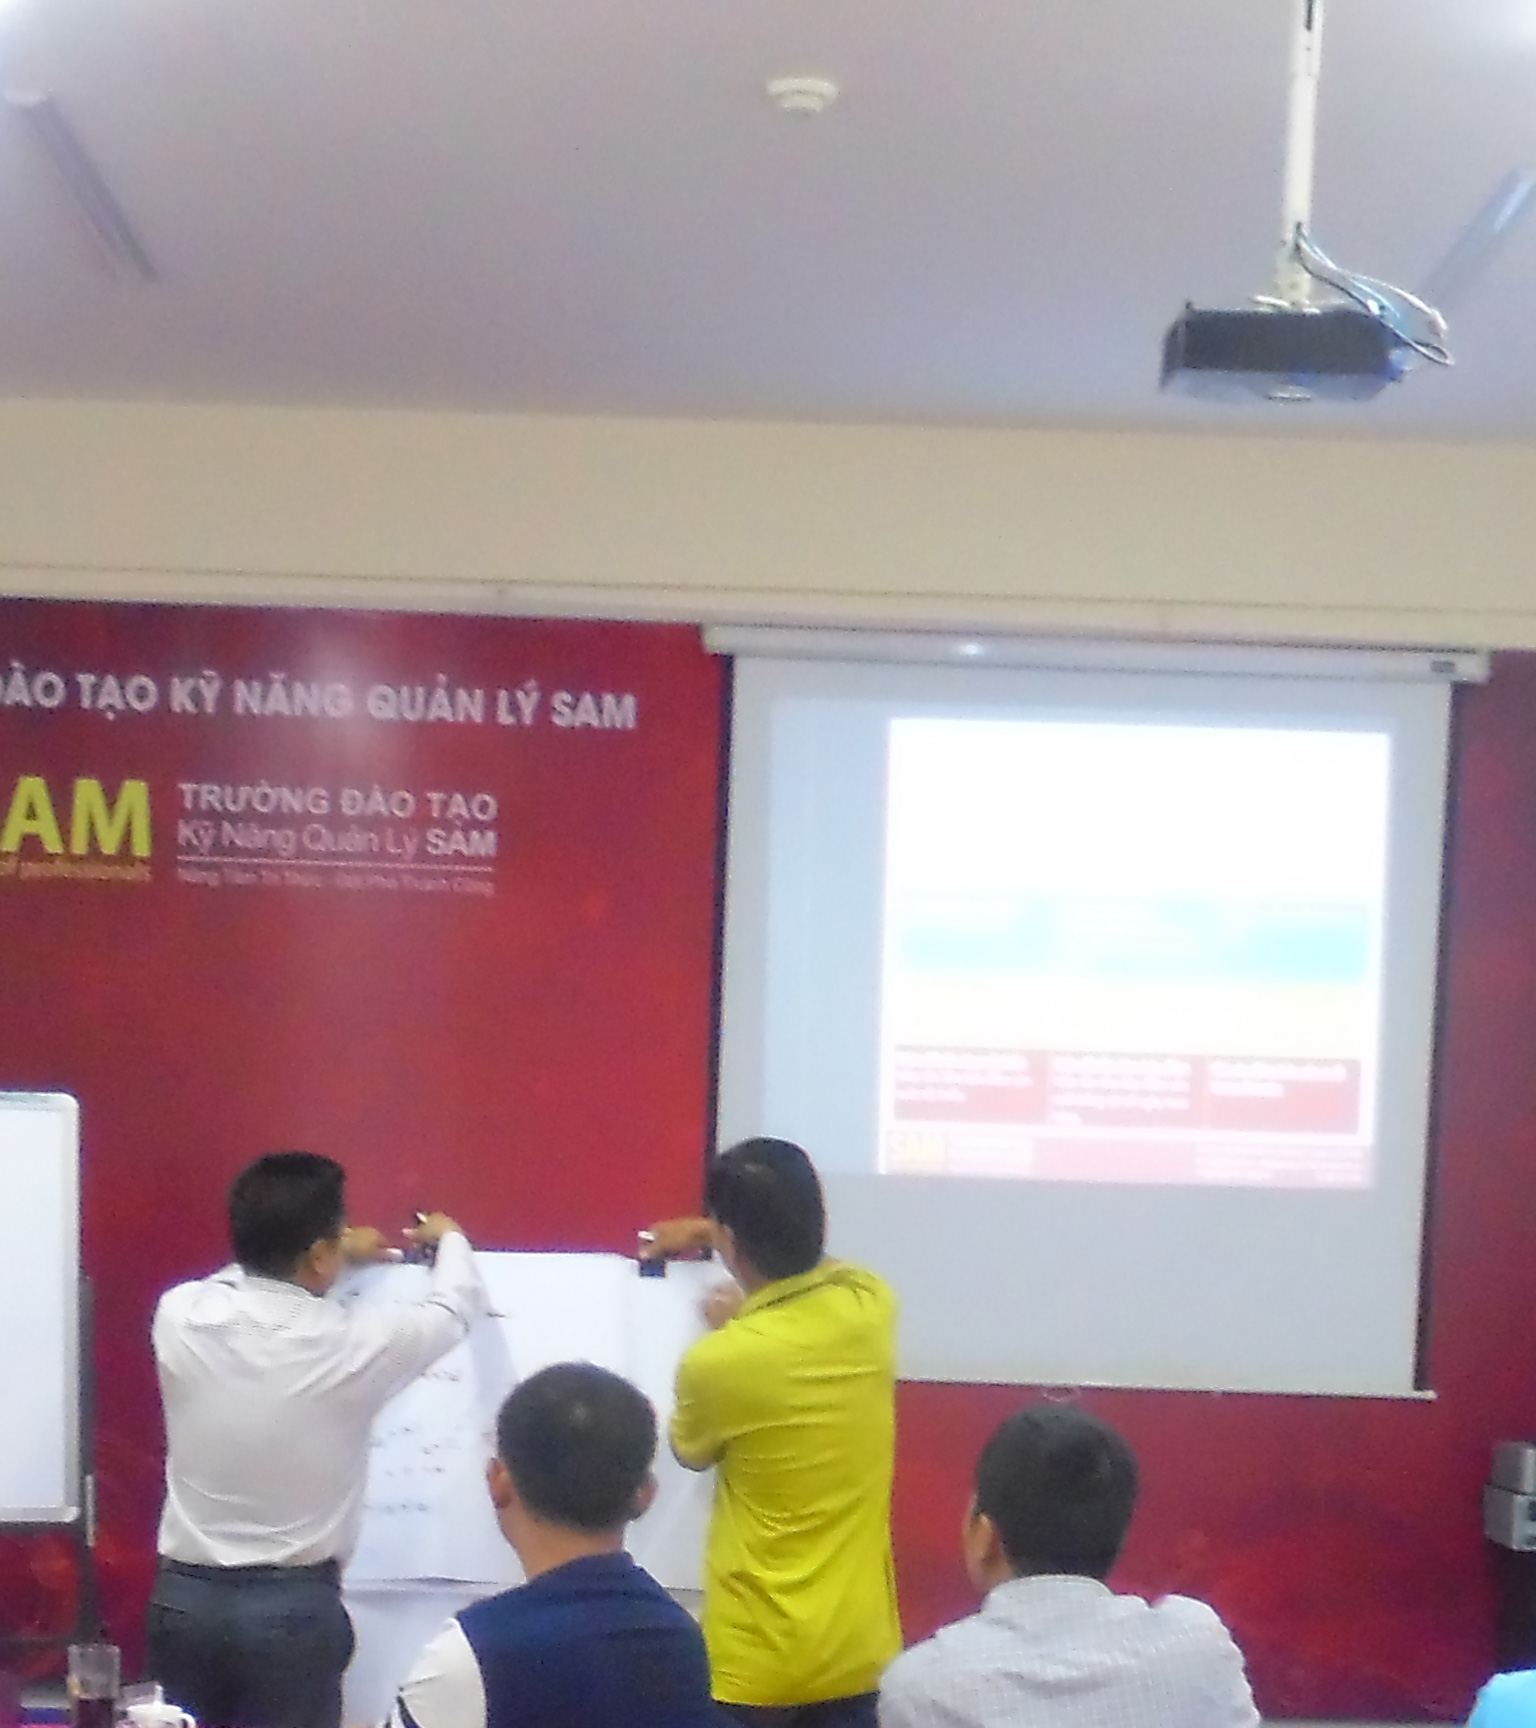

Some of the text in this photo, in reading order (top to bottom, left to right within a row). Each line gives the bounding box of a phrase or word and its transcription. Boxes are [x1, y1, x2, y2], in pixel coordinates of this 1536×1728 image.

[75, 672, 159, 721] TẠO
[170, 669, 221, 714] KỸ
[233, 671, 354, 718] NĂNG
[366, 672, 485, 724] QUẢN
[496, 677, 540, 726] LÝ
[550, 690, 638, 730] SAM
[177, 780, 499, 828] TRƯỜNG ĐÀO TẠO
[426, 827, 499, 857] SAM
